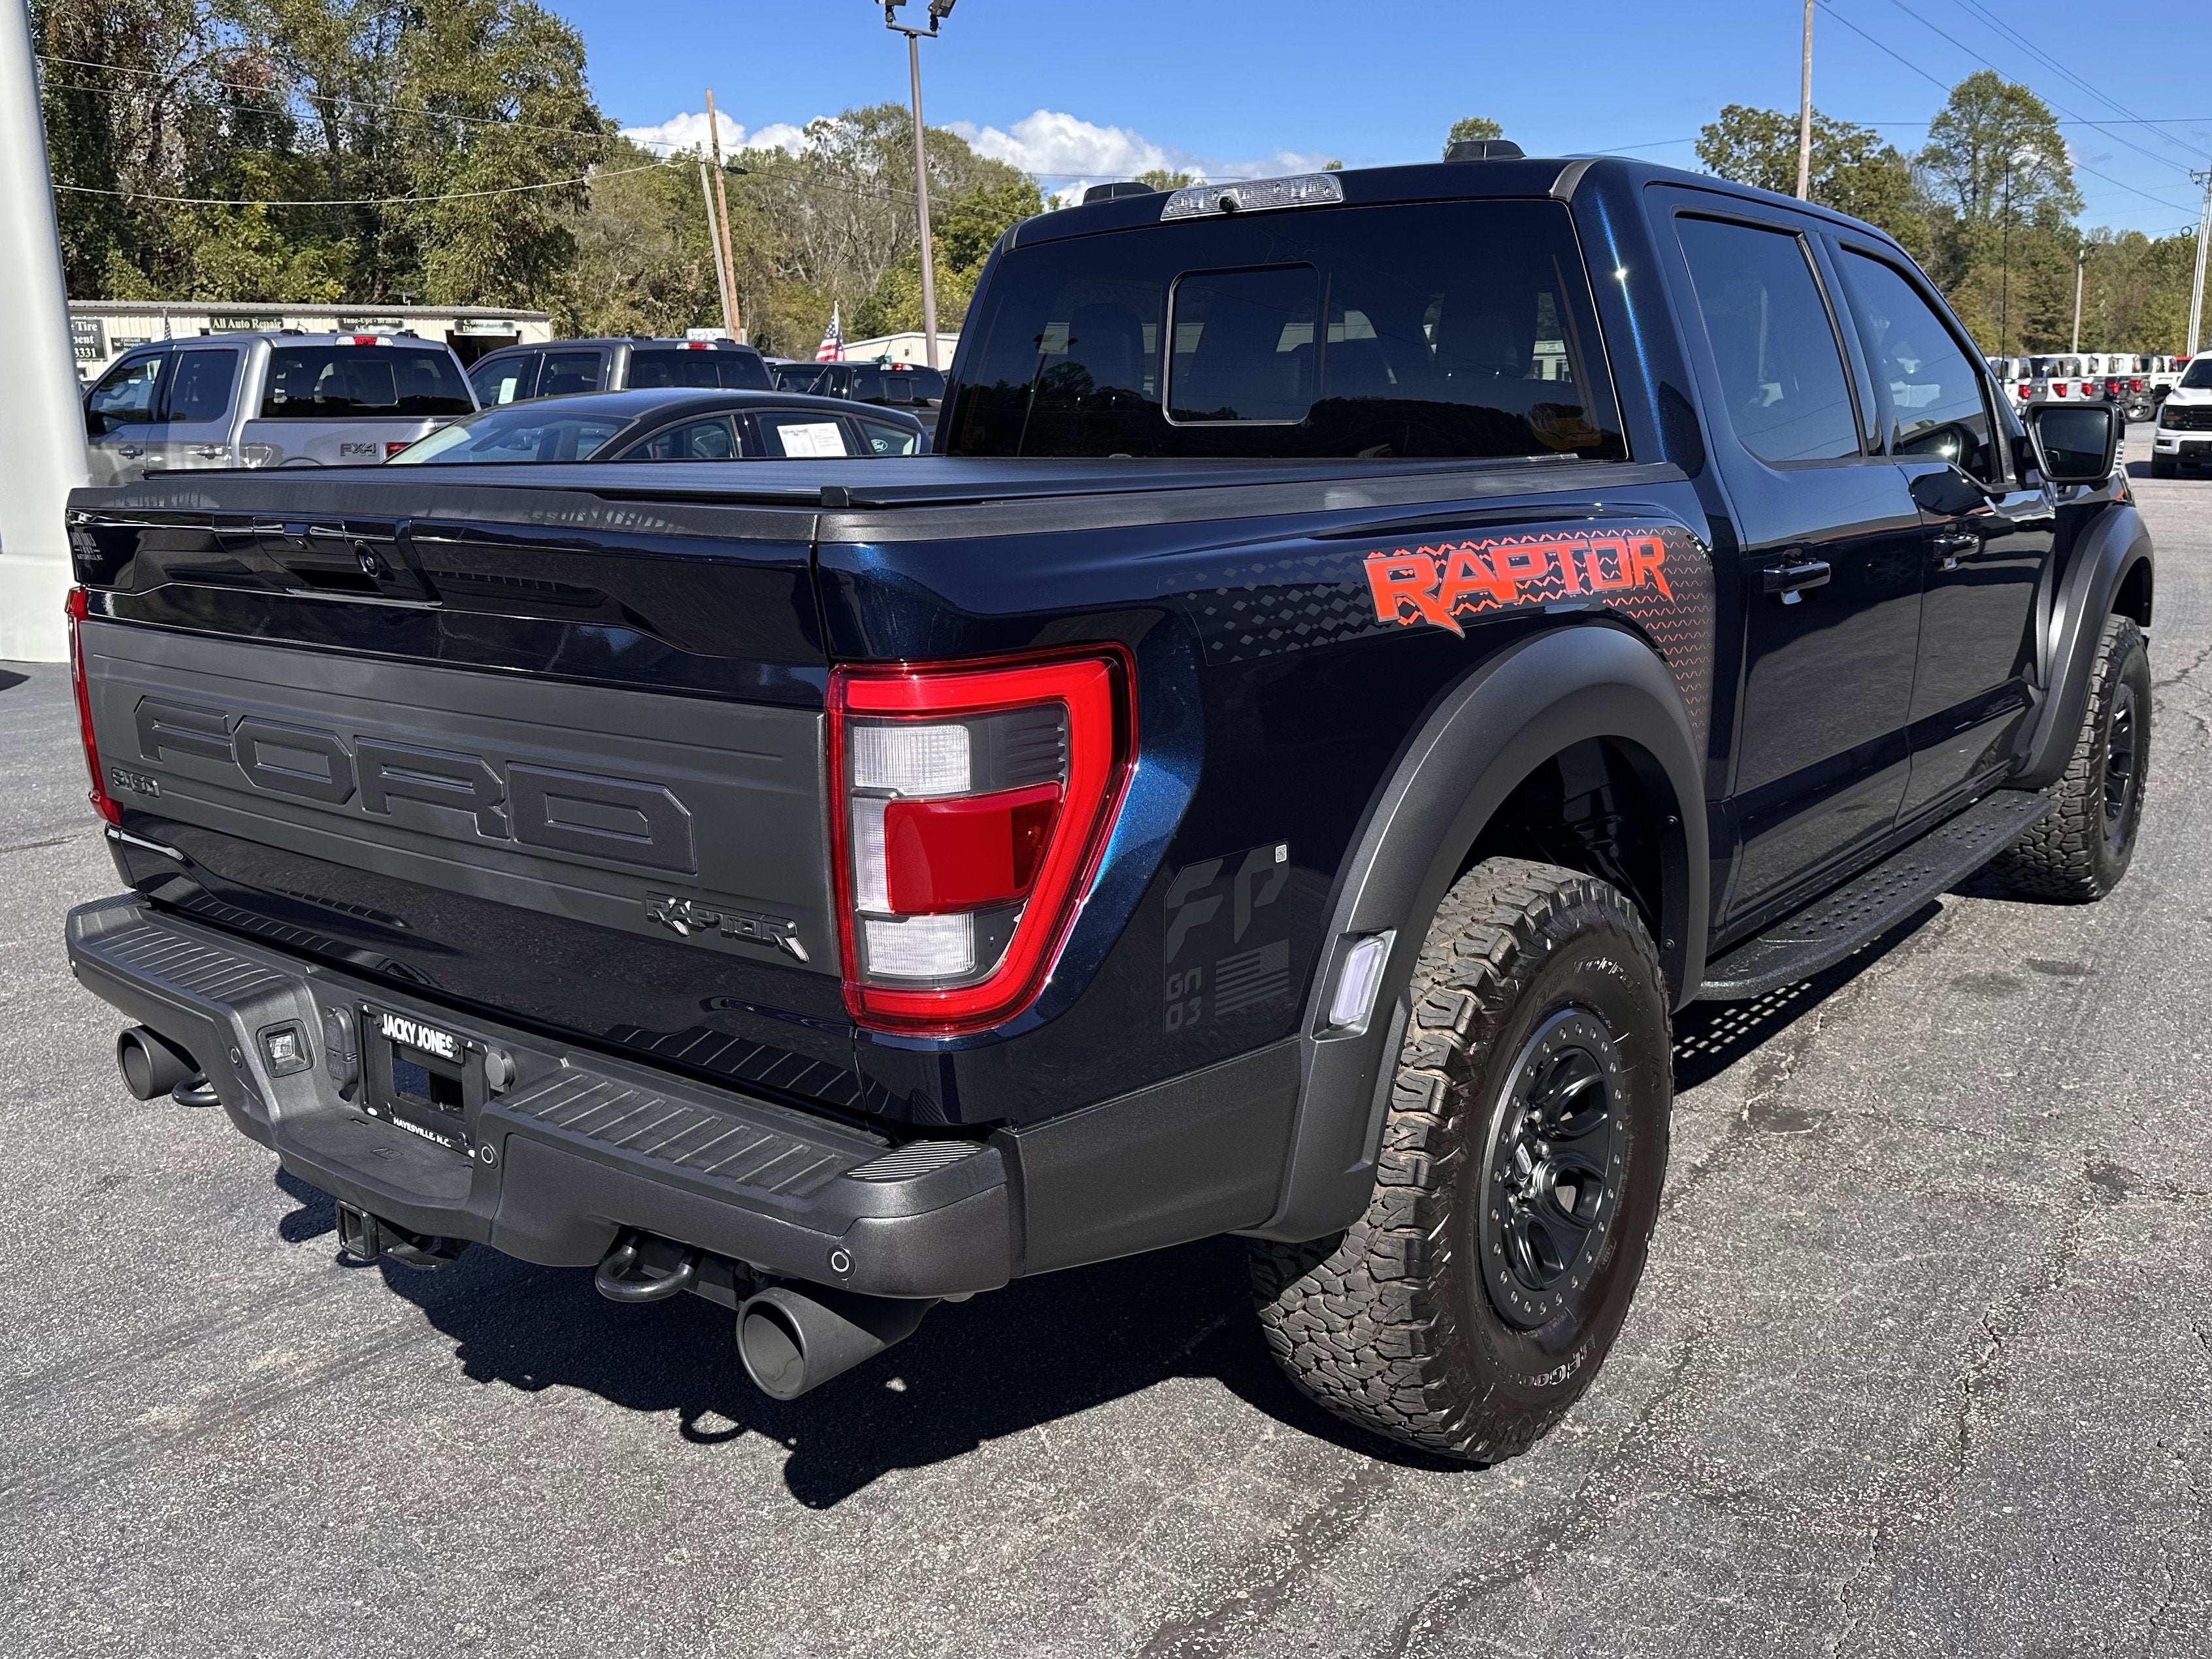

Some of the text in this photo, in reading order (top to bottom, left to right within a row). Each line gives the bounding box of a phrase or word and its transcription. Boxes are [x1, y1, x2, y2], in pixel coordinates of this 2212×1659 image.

[75, 321, 98, 331] Tire
[212, 318, 282, 331] All Auto Repair
[340, 442, 377, 457] FX4
[1363, 536, 1675, 638] RAPTOR
[133, 695, 697, 876] FORD
[646, 891, 810, 964] RAPTOR
[382, 1013, 454, 1058] JACKY JONES
